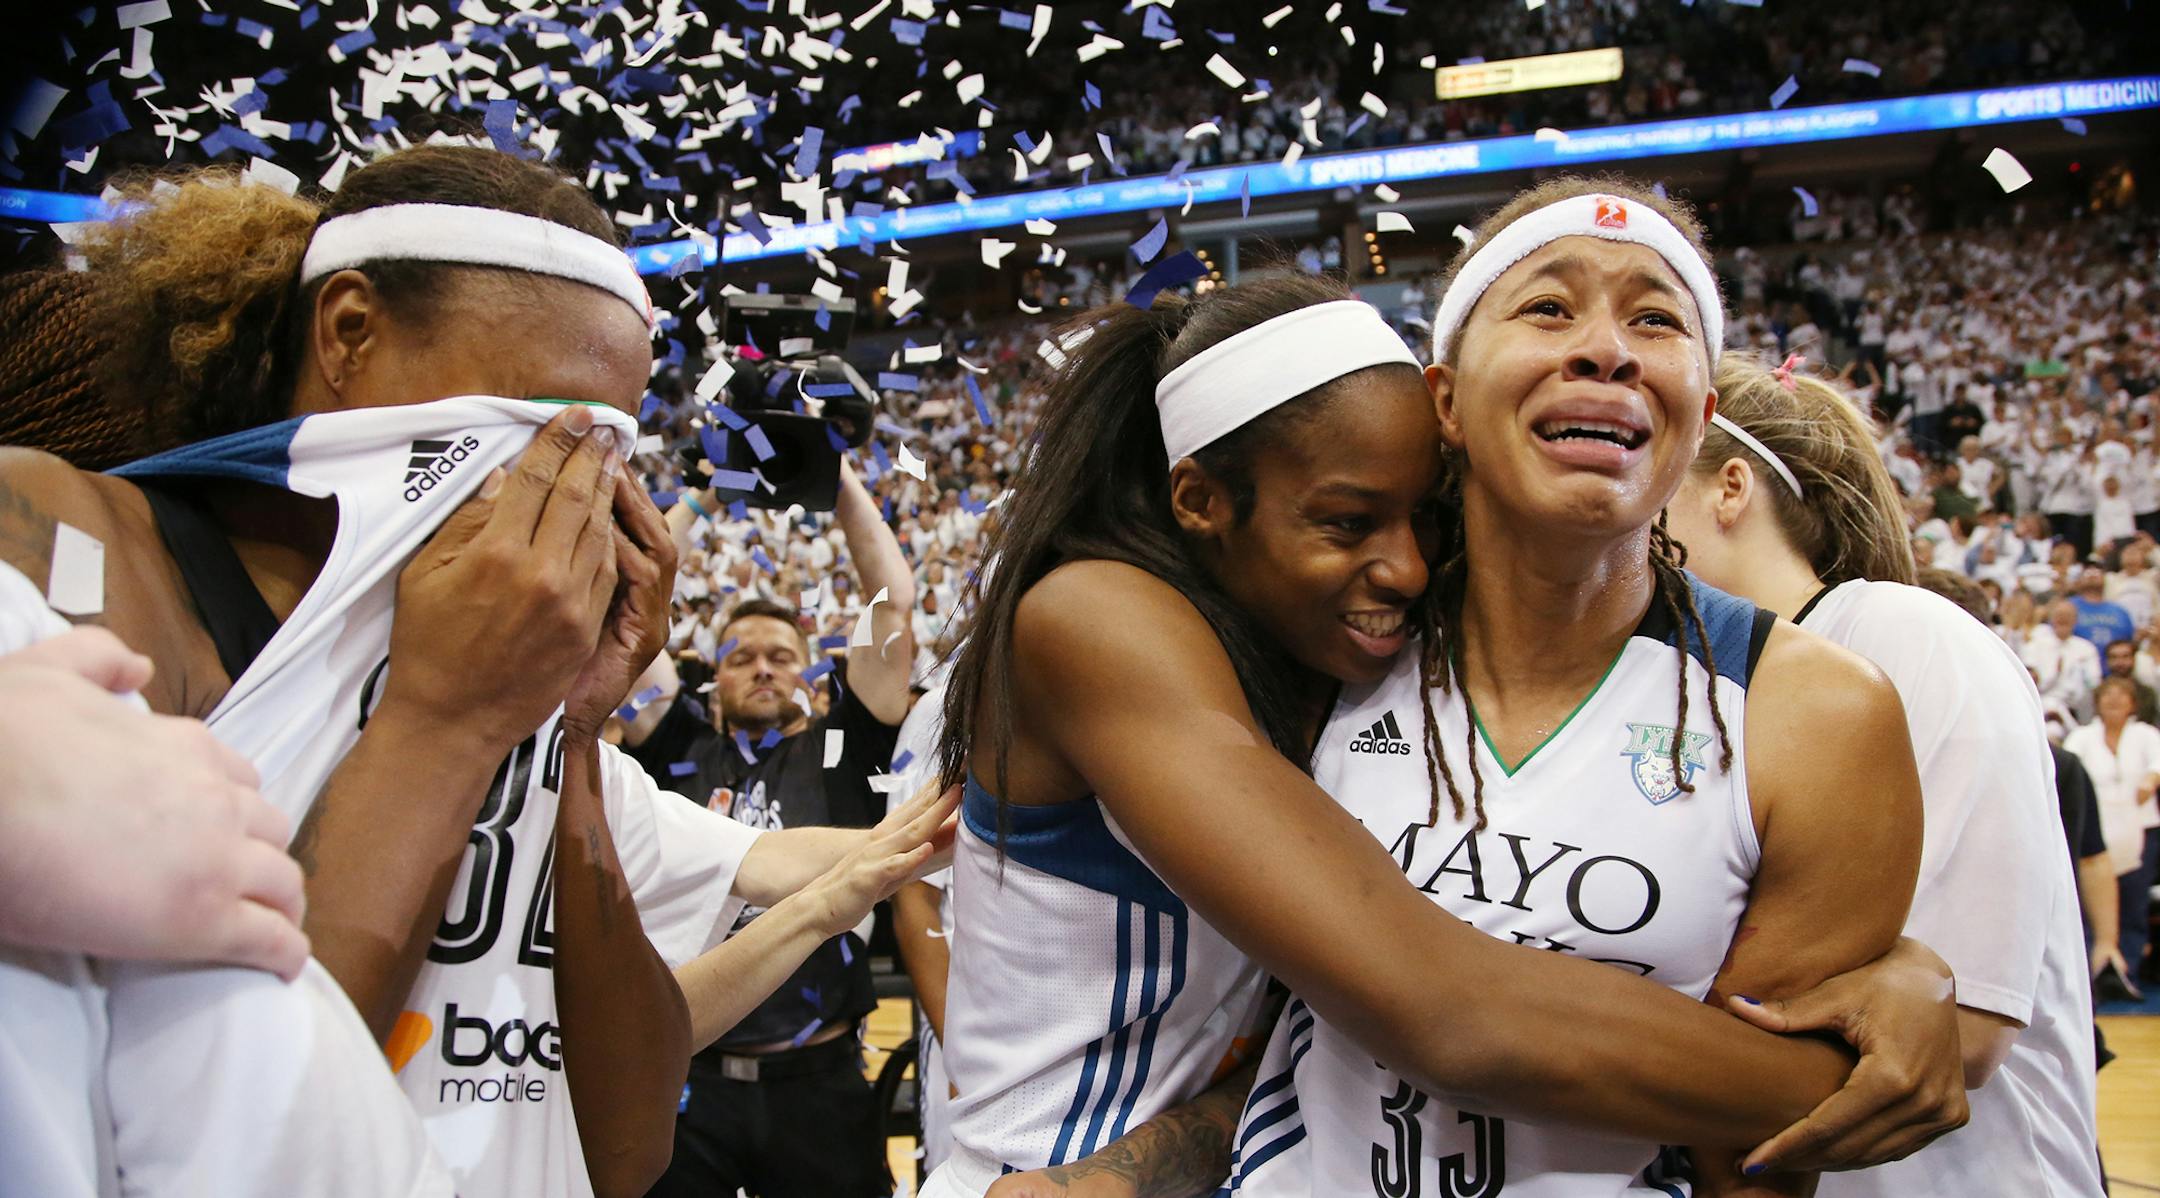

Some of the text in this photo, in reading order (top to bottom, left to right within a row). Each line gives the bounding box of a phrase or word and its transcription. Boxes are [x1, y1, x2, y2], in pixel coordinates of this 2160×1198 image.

[1977, 80, 2160, 119] SPORTS MEDICIN
[1310, 144, 1480, 185] SPORTS MEDICINE
[404, 436, 479, 502] adidas
[1350, 738, 1411, 755] adidas
